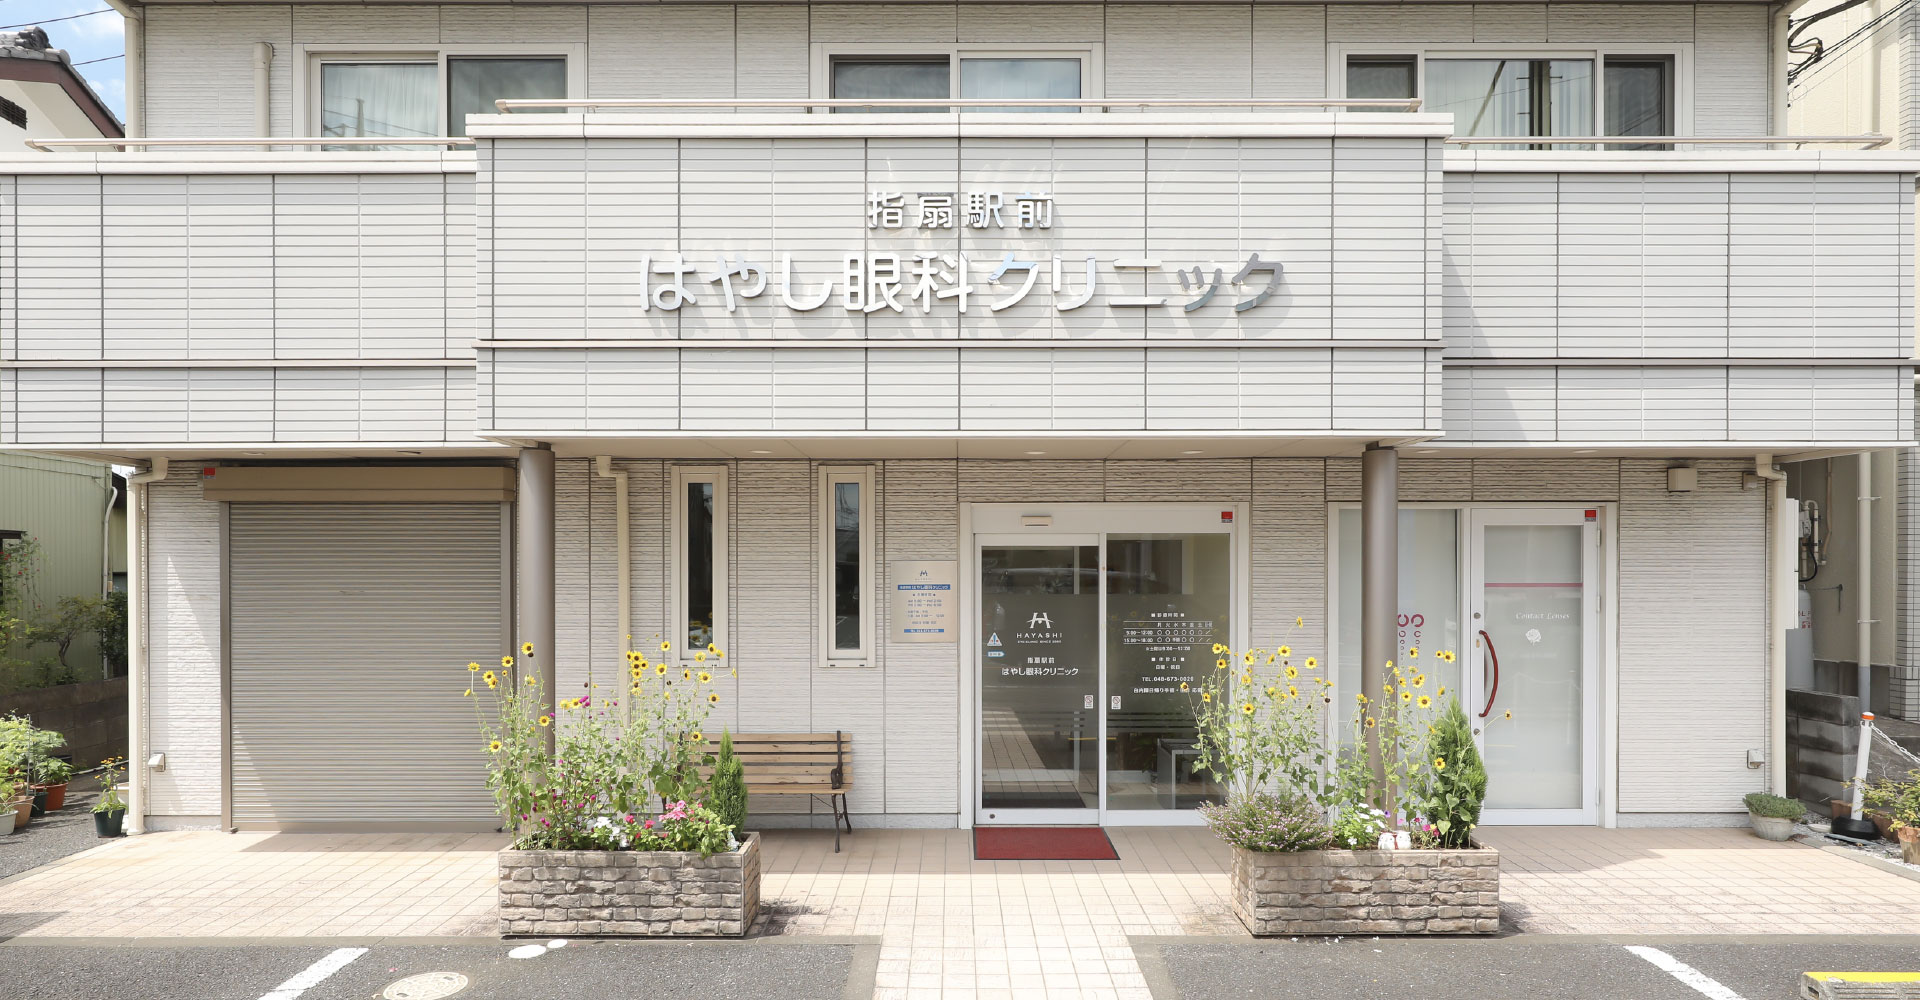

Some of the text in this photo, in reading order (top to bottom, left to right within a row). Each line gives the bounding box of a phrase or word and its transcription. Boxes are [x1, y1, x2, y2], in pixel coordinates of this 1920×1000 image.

[868, 190, 1054, 230] 指扇駅前
[639, 252, 1285, 314] はやし眼科クリニック
[1515, 612, 1570, 620] Contact Lenses
[1027, 656, 1055, 664] 指扇駅前
[1001, 667, 1079, 676] はやし眼科クリニック
